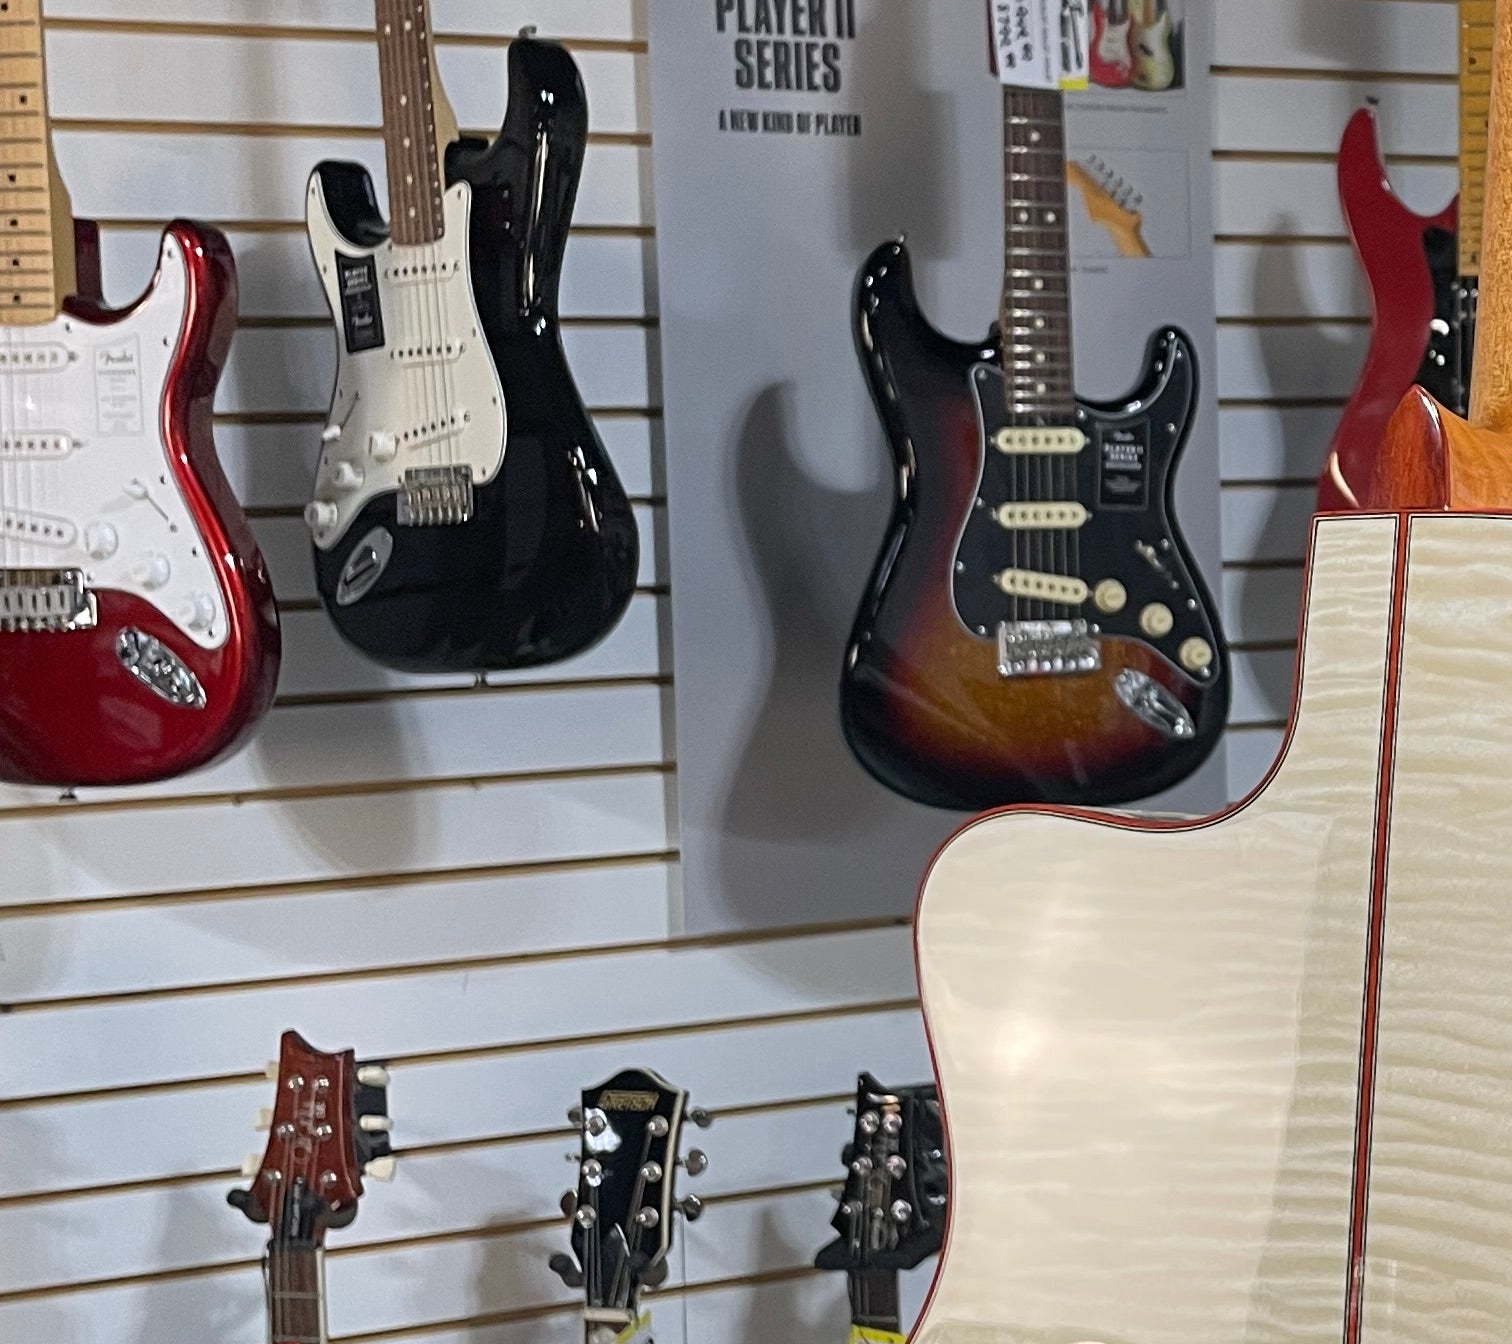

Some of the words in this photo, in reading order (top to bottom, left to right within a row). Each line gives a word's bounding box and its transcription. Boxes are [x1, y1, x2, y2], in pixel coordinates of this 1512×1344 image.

[734, 38, 842, 93] SERIES
[719, 109, 727, 131] A
[731, 110, 759, 132] NEW
[763, 112, 794, 134] KIND
[797, 113, 812, 134] OF
[816, 113, 862, 137] PLAYER
